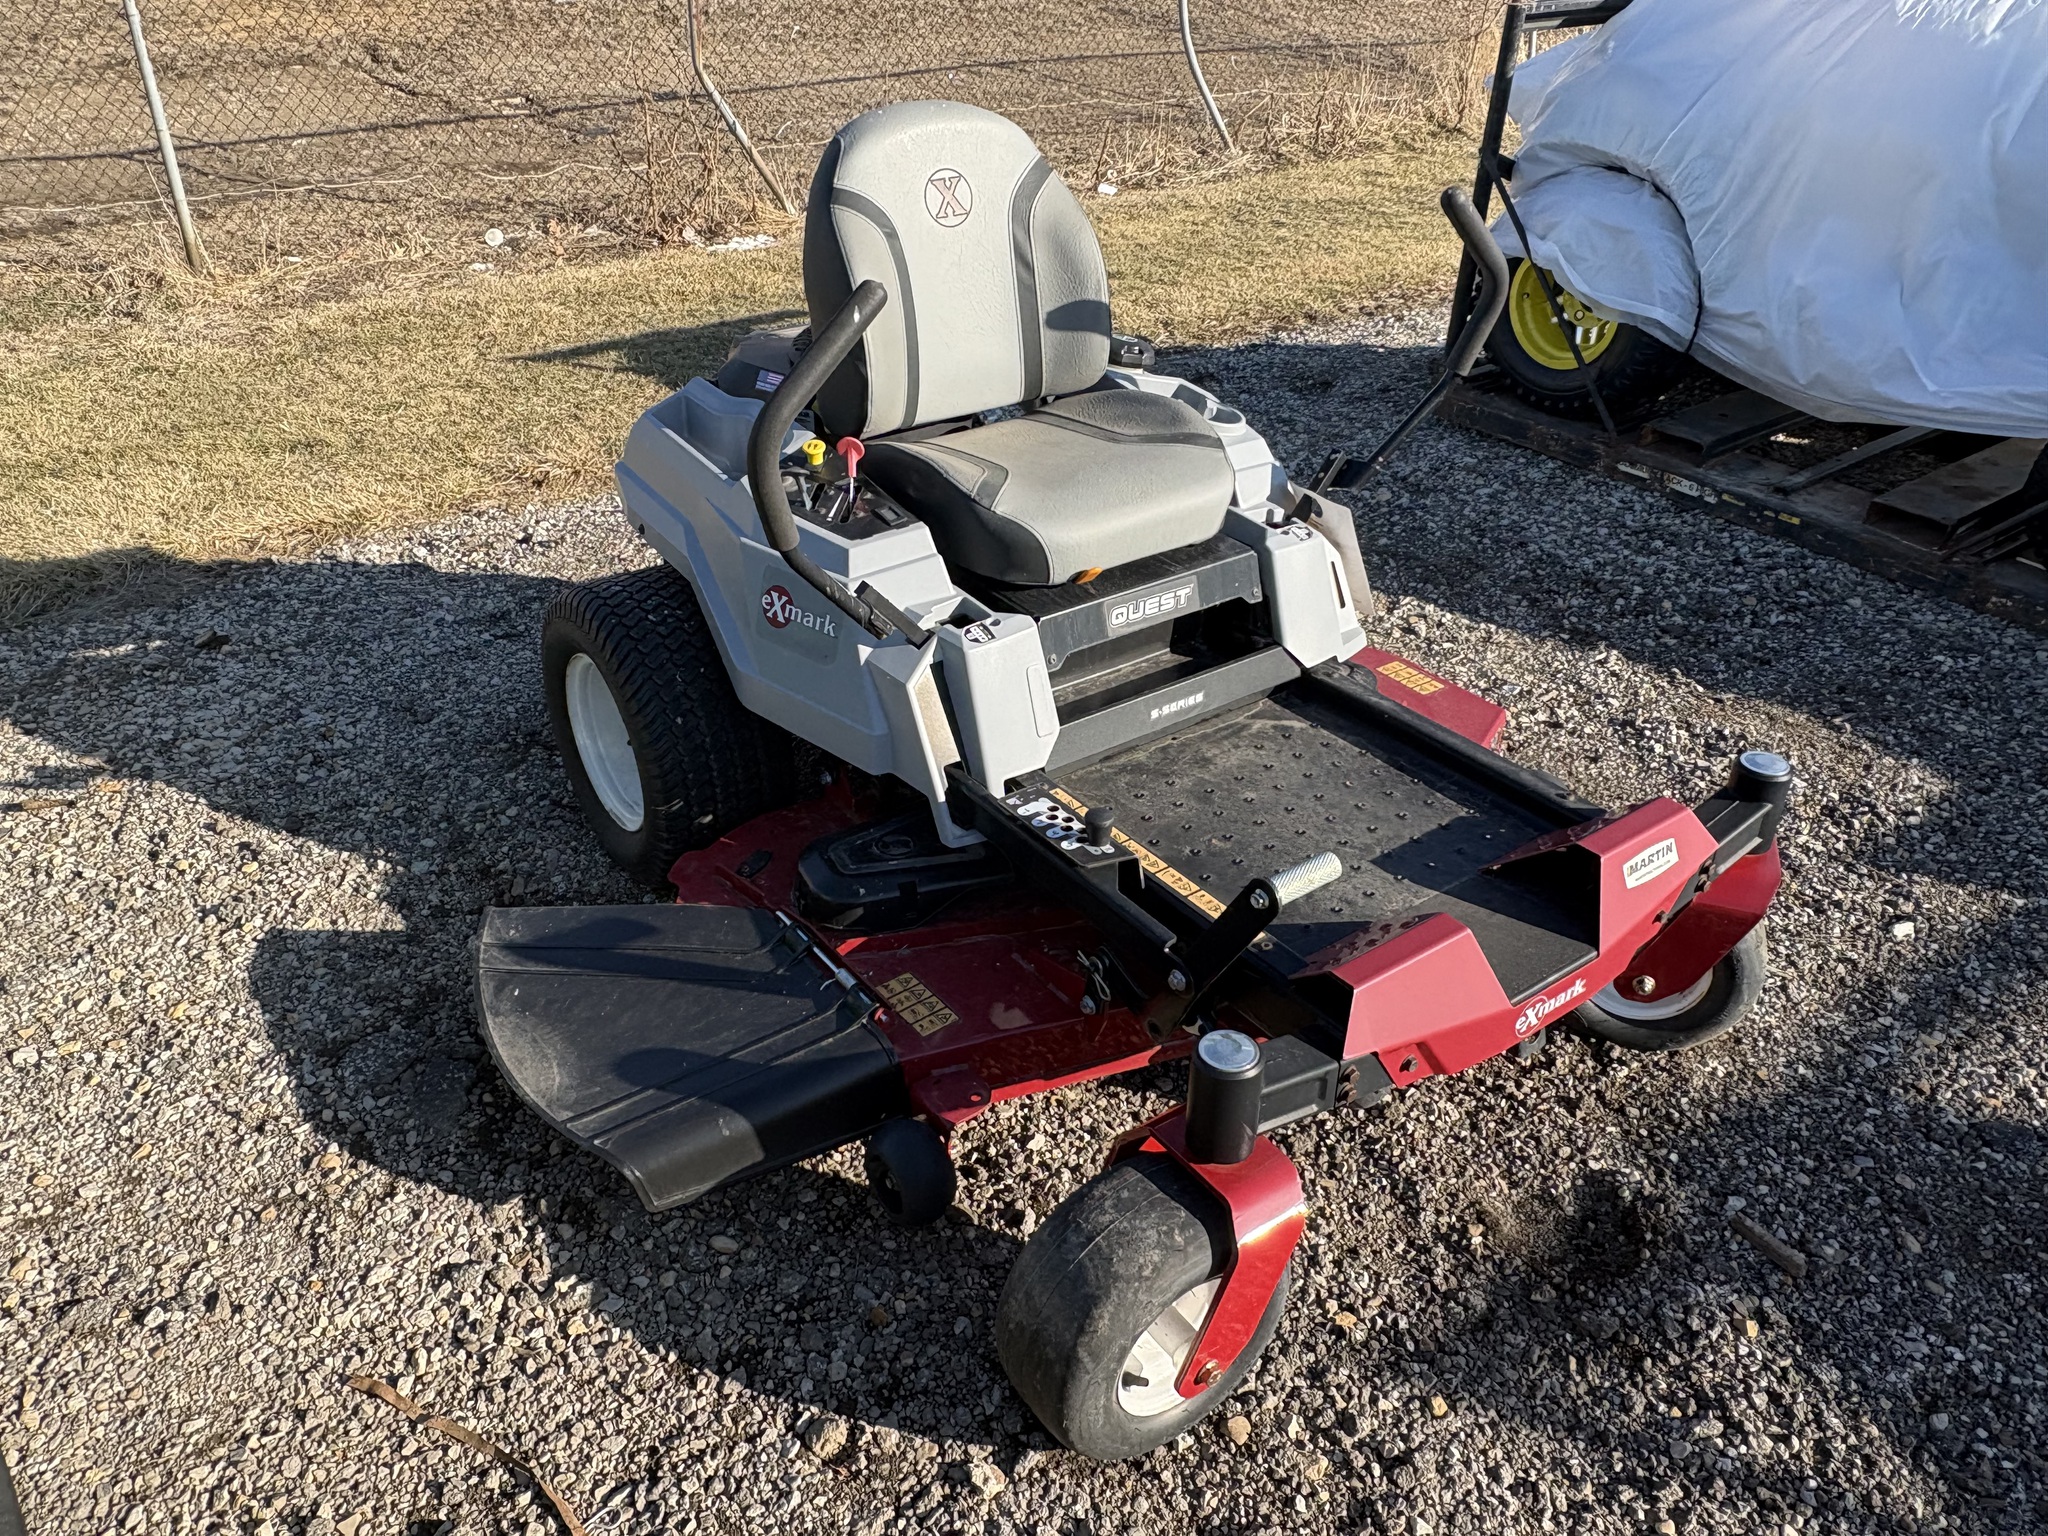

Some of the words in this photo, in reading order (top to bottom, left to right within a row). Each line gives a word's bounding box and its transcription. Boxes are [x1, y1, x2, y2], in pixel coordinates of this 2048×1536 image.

[761, 590, 837, 637] eXmark
[1110, 584, 1194, 628] QUEST
[1515, 978, 1587, 1033] eXmark
